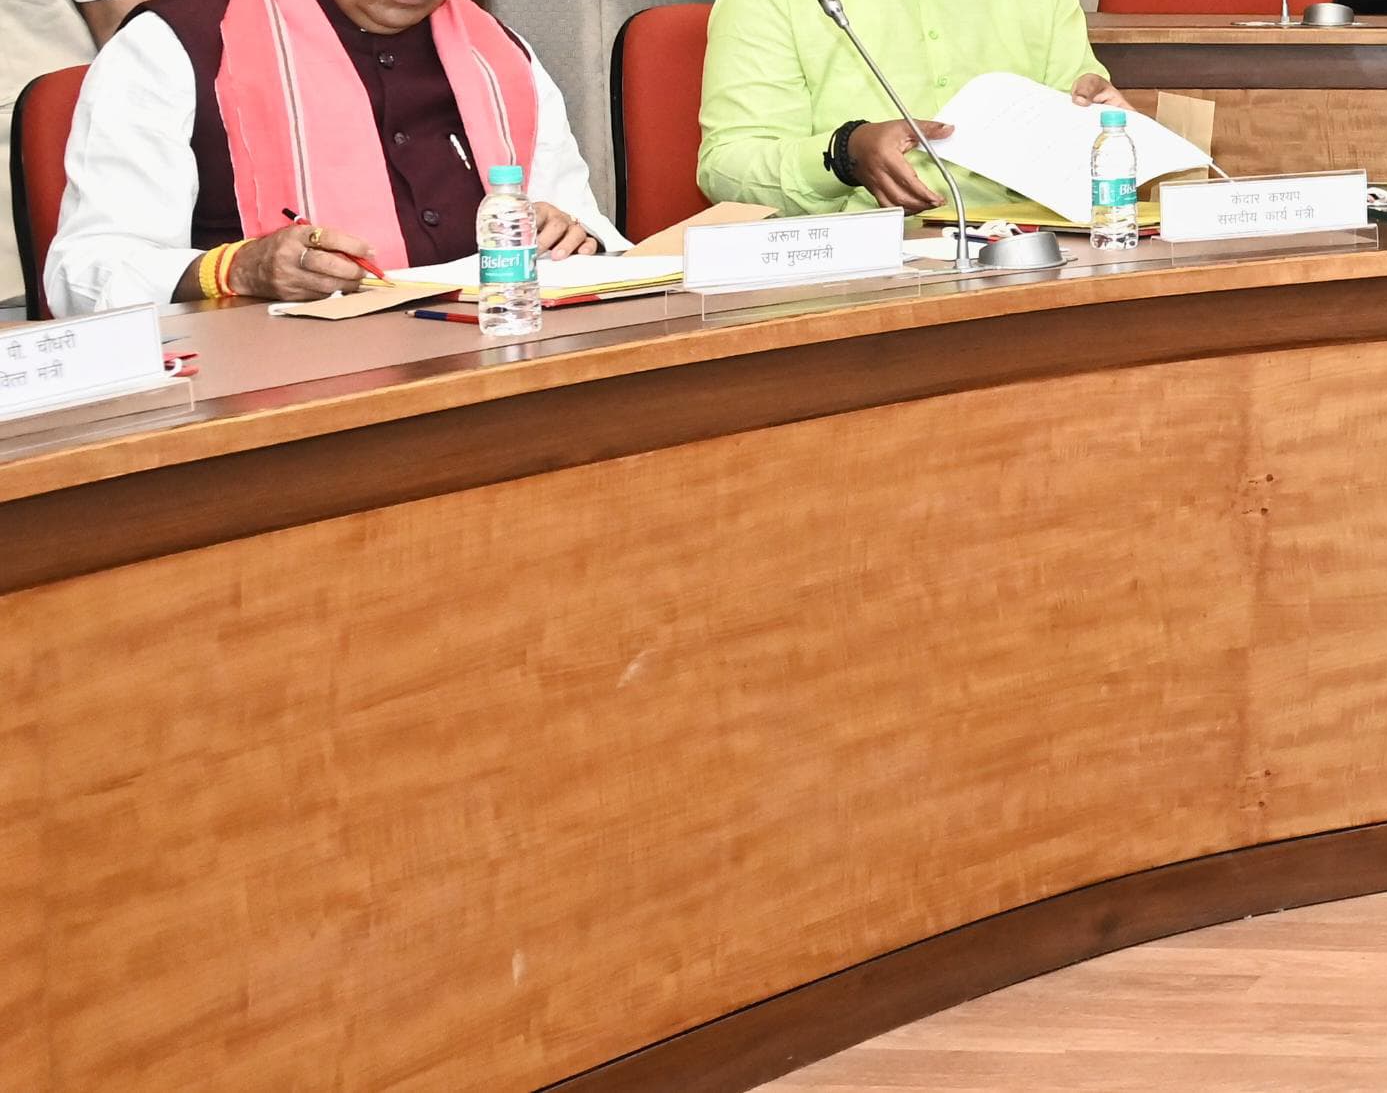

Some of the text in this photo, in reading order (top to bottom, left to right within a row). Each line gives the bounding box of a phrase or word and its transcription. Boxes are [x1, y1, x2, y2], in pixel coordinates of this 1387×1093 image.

[1230, 190, 1301, 204] केदार कश्यप
[1264, 205, 1288, 221] कार्य
[1294, 204, 1315, 219] मंत्री
[808, 227, 830, 240] साव
[480, 253, 520, 269] Bisleri
[760, 243, 834, 267] उप मुख्यमंत्री
